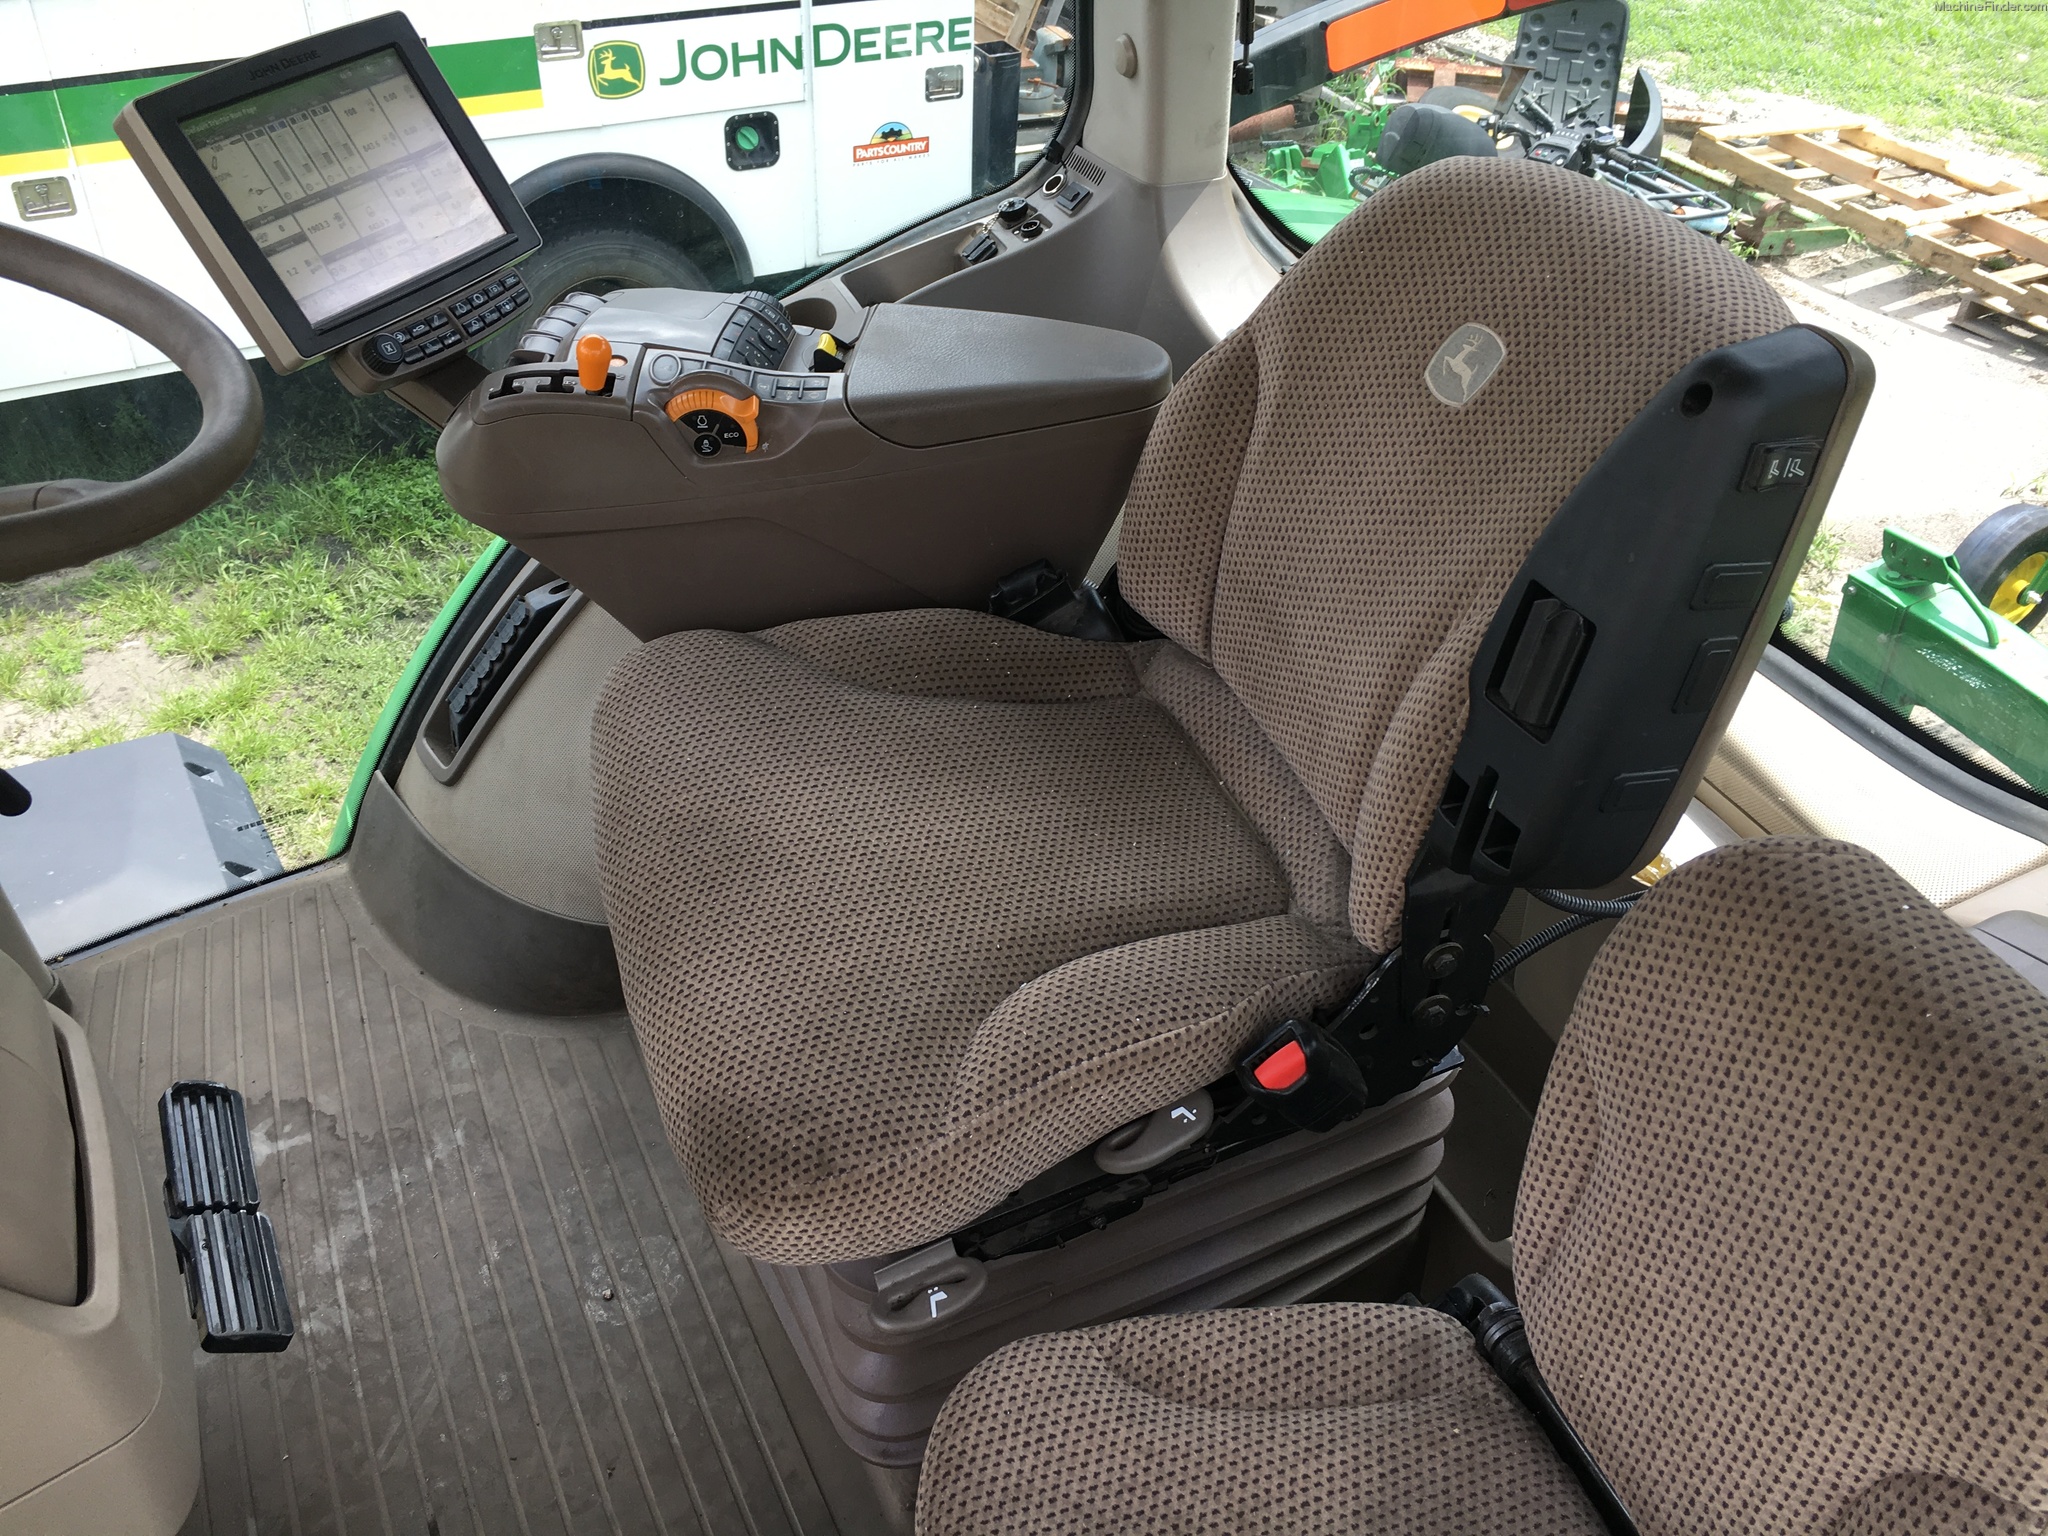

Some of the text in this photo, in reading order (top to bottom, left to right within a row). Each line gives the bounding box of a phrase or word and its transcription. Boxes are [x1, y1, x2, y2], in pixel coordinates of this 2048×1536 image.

[250, 51, 320, 81] JOHN DEERE
[660, 16, 973, 86] JOHN DEERE
